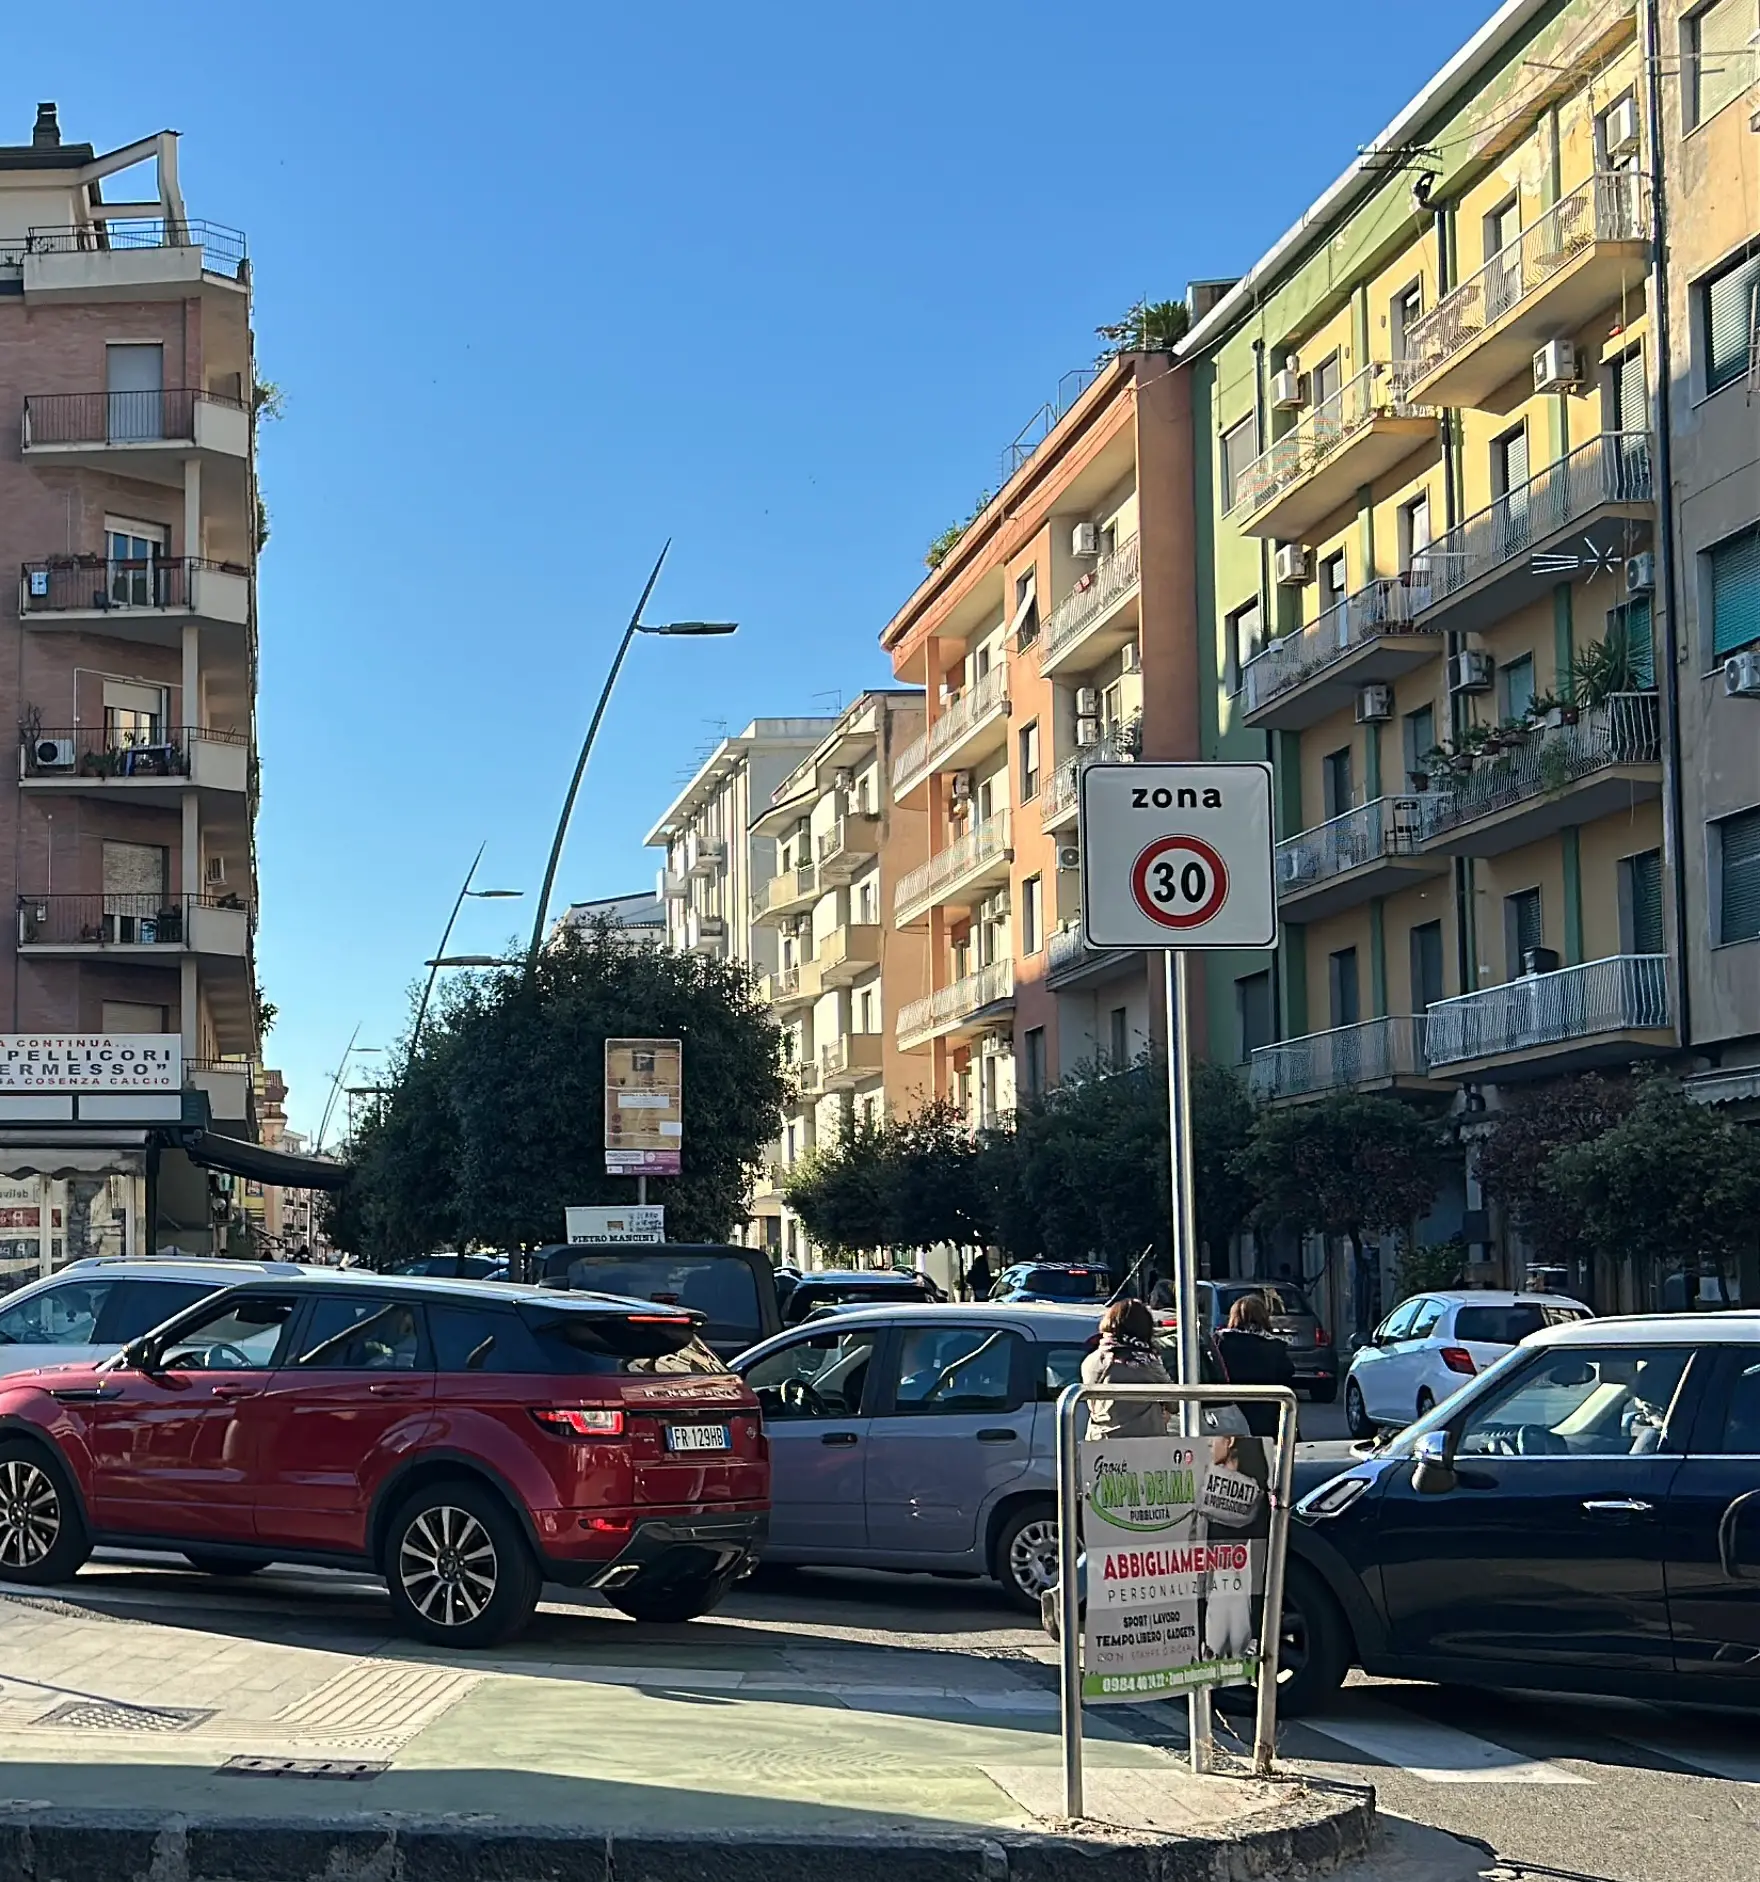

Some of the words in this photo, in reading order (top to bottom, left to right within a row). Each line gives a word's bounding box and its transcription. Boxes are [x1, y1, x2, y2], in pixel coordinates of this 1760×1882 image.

[1132, 788, 1222, 808] zona
[1153, 862, 1206, 903] 30
[8, 1050, 171, 1061] PELLICORI
[25, 1077, 100, 1086] COSENZA
[110, 1077, 170, 1086] CALCIO
[1094, 1455, 1128, 1480] Group
[1206, 1474, 1255, 1503] AFFIDATI
[1103, 1544, 1248, 1581] ABBIGLIAMENTO
[1108, 1578, 1242, 1603] PERSONALIZATO
[1124, 1614, 1148, 1629] SPORT
[1153, 1611, 1180, 1625] LAVORO
[1096, 1634, 1134, 1648] TEMPO
[1136, 1631, 1162, 1644] LIBERO
[1167, 1625, 1196, 1640] GADGETS
